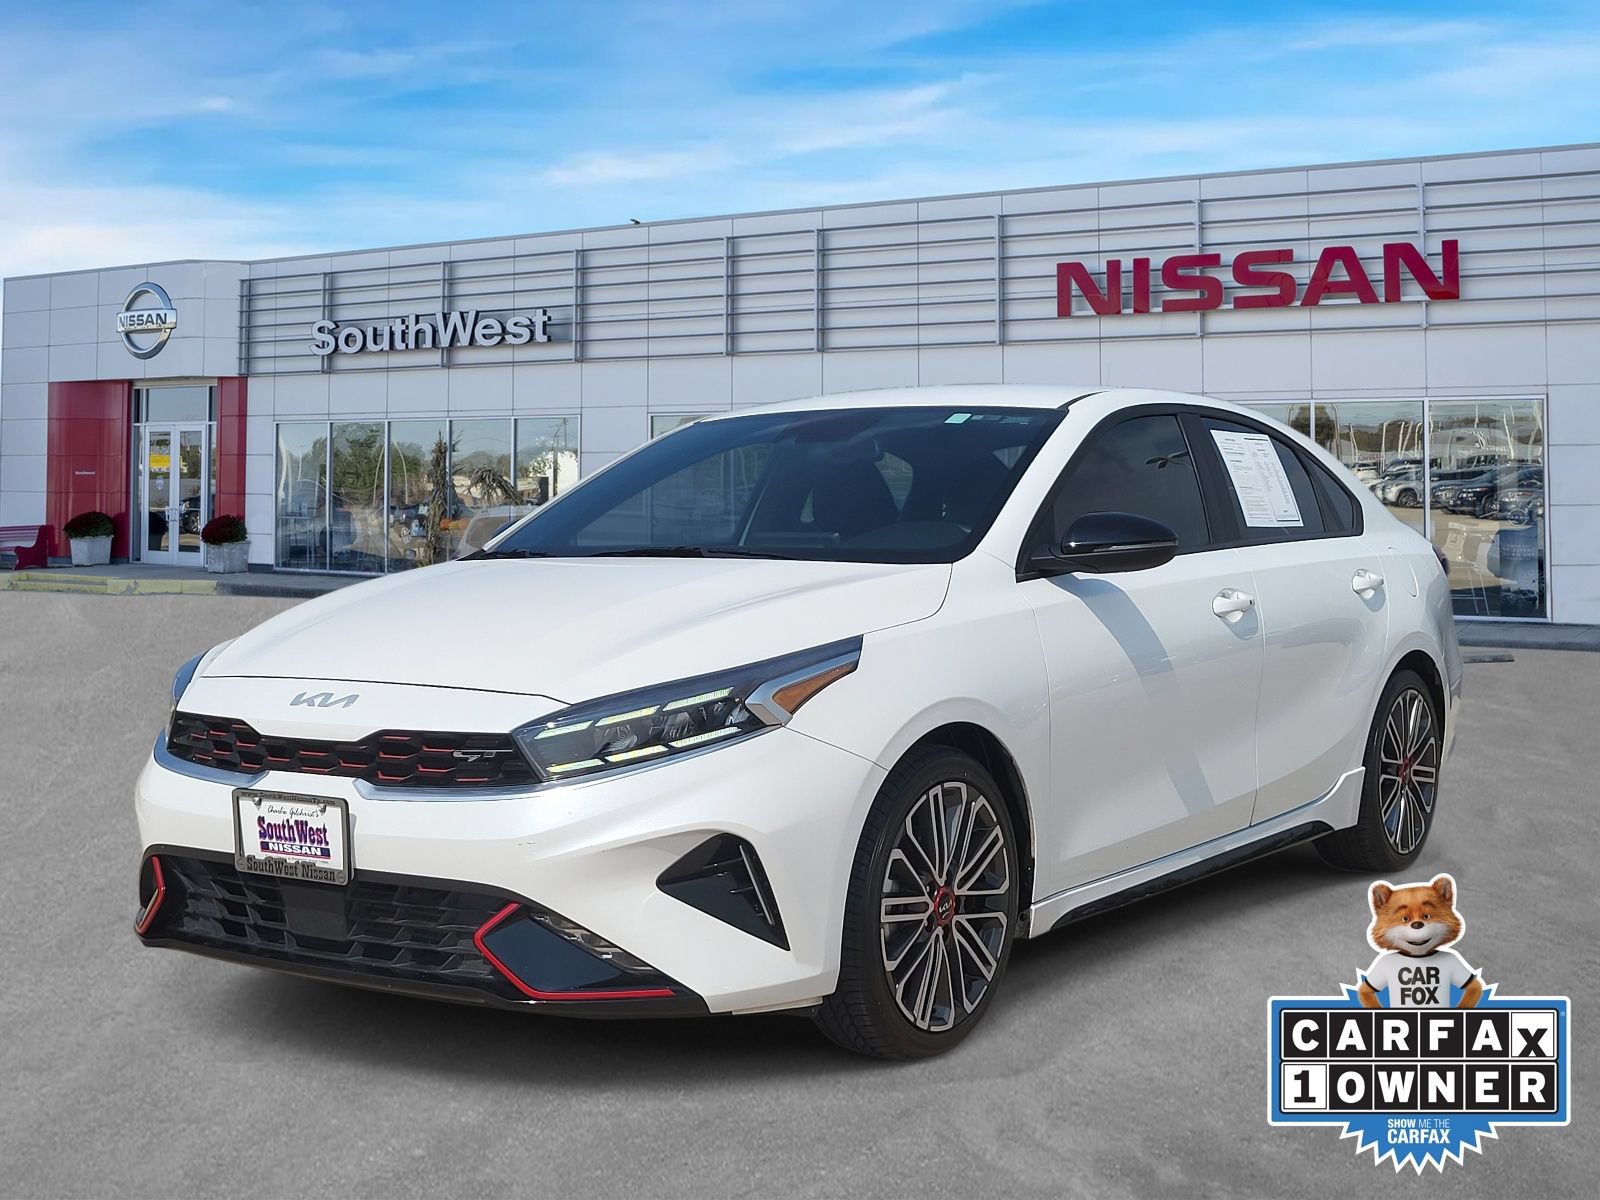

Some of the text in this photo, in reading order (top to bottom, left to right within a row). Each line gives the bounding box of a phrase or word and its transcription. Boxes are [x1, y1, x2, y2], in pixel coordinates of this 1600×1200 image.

[1056, 239, 1460, 318] NISSAN
[119, 313, 167, 328] NISSAN
[309, 308, 551, 356] SouthWest
[257, 816, 330, 846] SouthWest
[268, 842, 322, 855] NISSAN
[246, 856, 299, 877] SouthWest
[301, 862, 336, 882] Nissan
